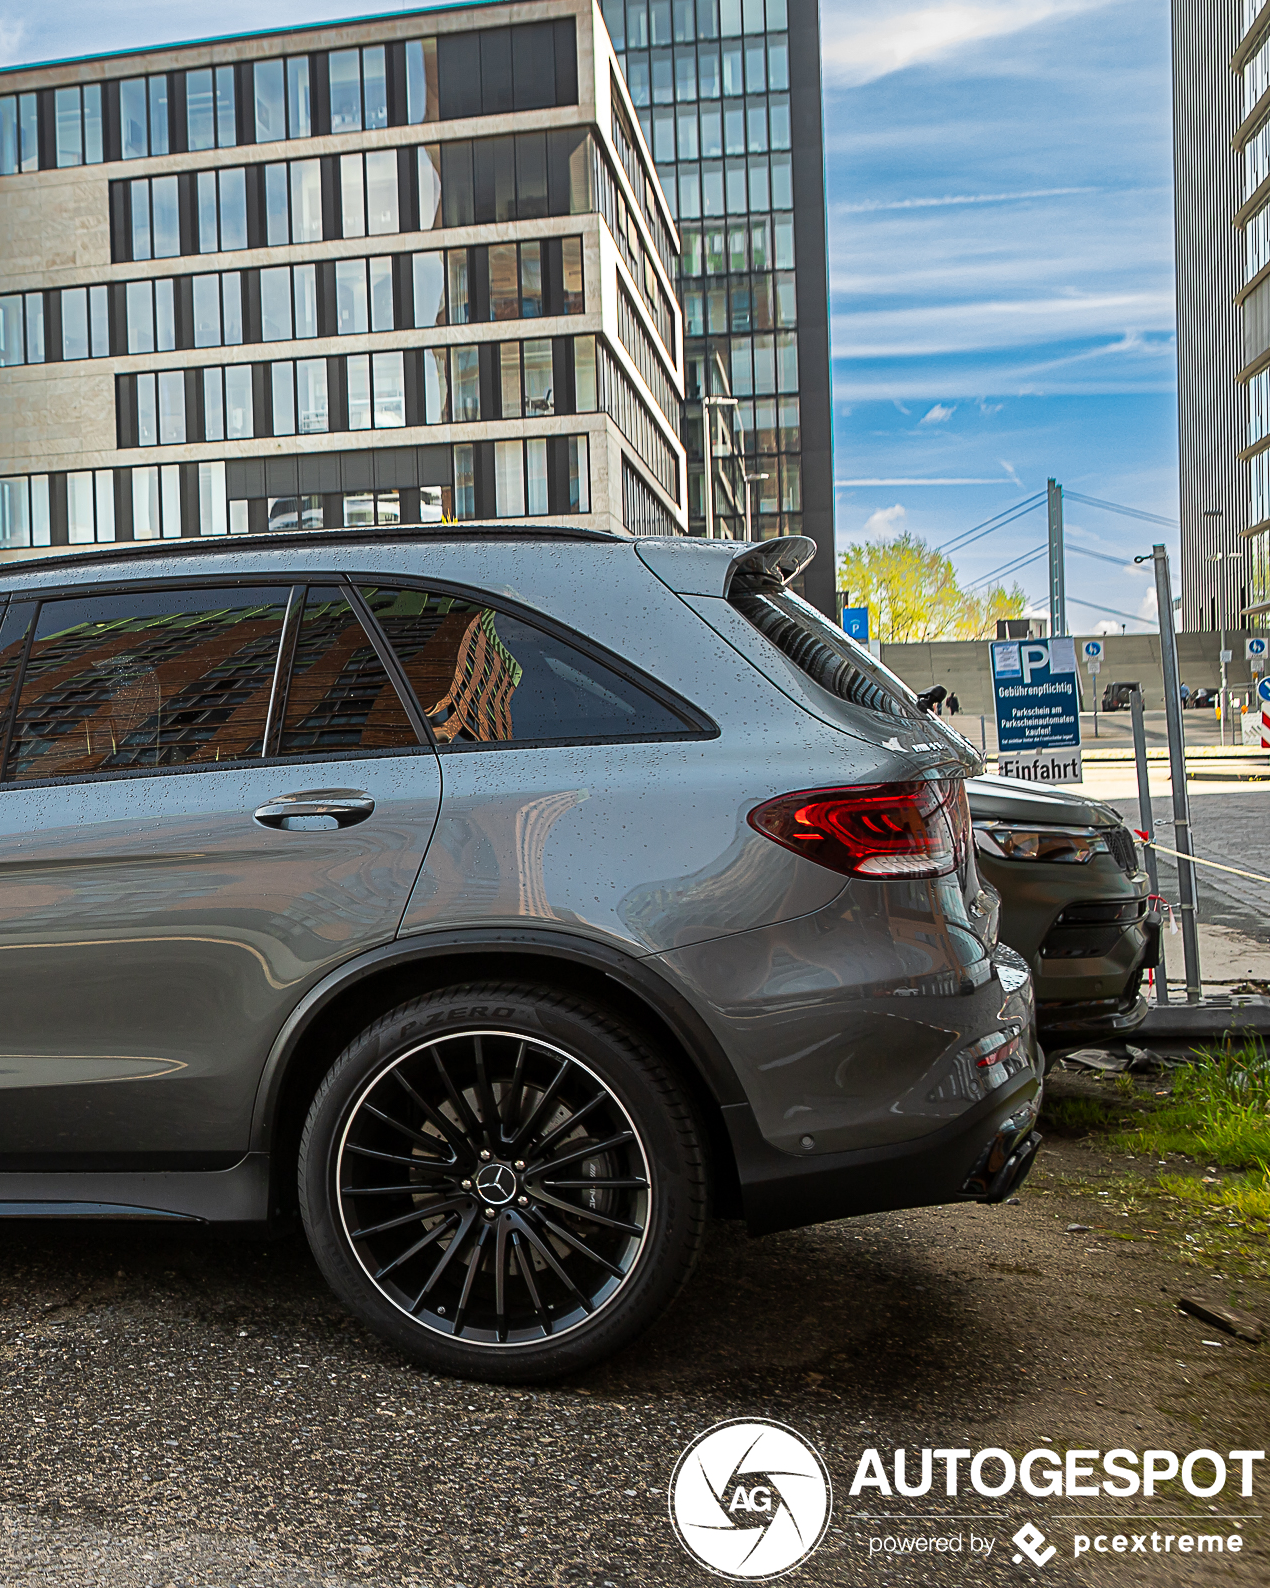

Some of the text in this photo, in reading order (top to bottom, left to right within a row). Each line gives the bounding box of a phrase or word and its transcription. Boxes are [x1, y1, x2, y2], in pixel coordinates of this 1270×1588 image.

[1021, 644, 1050, 684] P
[998, 681, 1073, 698] Gebührenpflichtig
[1012, 706, 1063, 717] Parkschein am
[1001, 715, 1075, 728] Parkscheinautomaten
[1025, 726, 1052, 737] kaufen!
[1003, 758, 1079, 781] Einfahrt
[422, 1005, 517, 1027] ZERO
